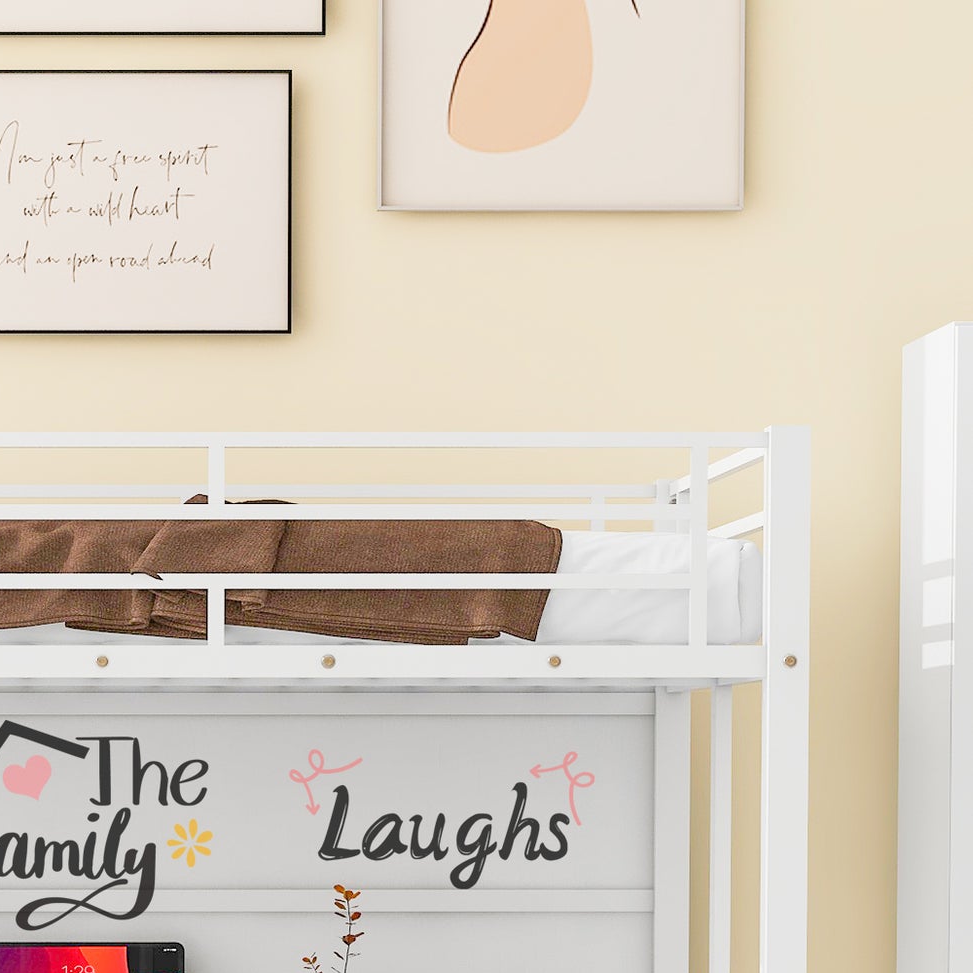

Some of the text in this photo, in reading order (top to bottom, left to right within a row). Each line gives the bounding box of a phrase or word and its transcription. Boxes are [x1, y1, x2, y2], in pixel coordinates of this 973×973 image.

[44, 139, 102, 189] just
[159, 144, 218, 181] spirit
[23, 192, 59, 226] with
[88, 192, 124, 226] wild
[129, 186, 195, 220] heart
[108, 243, 153, 270] road
[157, 240, 216, 270] ahead
[76, 736, 209, 806] The
[318, 781, 571, 890] Laughs
